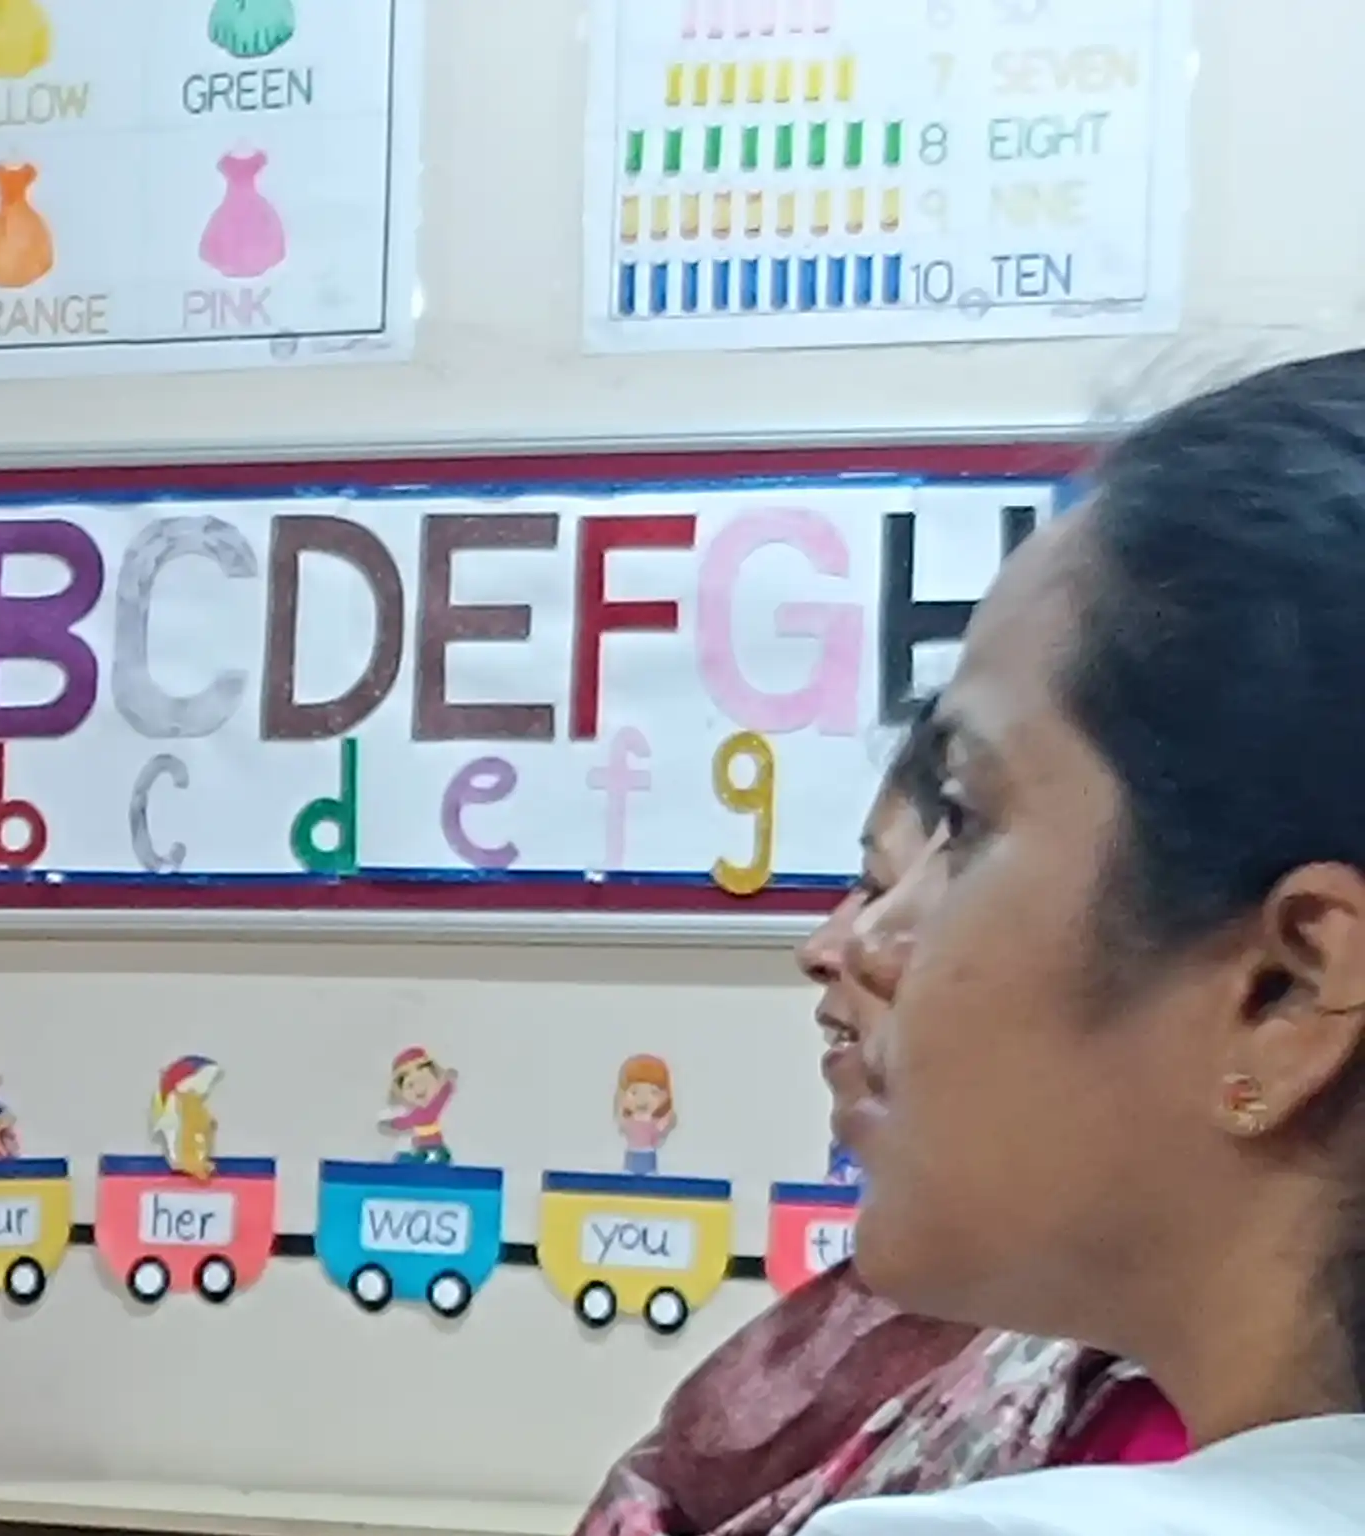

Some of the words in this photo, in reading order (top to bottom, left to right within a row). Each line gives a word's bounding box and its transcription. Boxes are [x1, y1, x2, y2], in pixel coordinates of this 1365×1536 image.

[182, 67, 315, 115] GREEN
[927, 52, 957, 97] 7
[919, 121, 948, 166] 8
[988, 109, 1112, 162] EIGHT
[919, 187, 949, 237] 9
[910, 259, 953, 304] 10
[991, 253, 1072, 297] TEN
[182, 287, 273, 331] PINK
[130, 753, 191, 873] c
[289, 736, 358, 876] d
[441, 755, 520, 870] e
[589, 725, 652, 866] f
[711, 731, 776, 895] g
[150, 1198, 216, 1241] her
[370, 1209, 458, 1247] was
[592, 1221, 669, 1263] you
